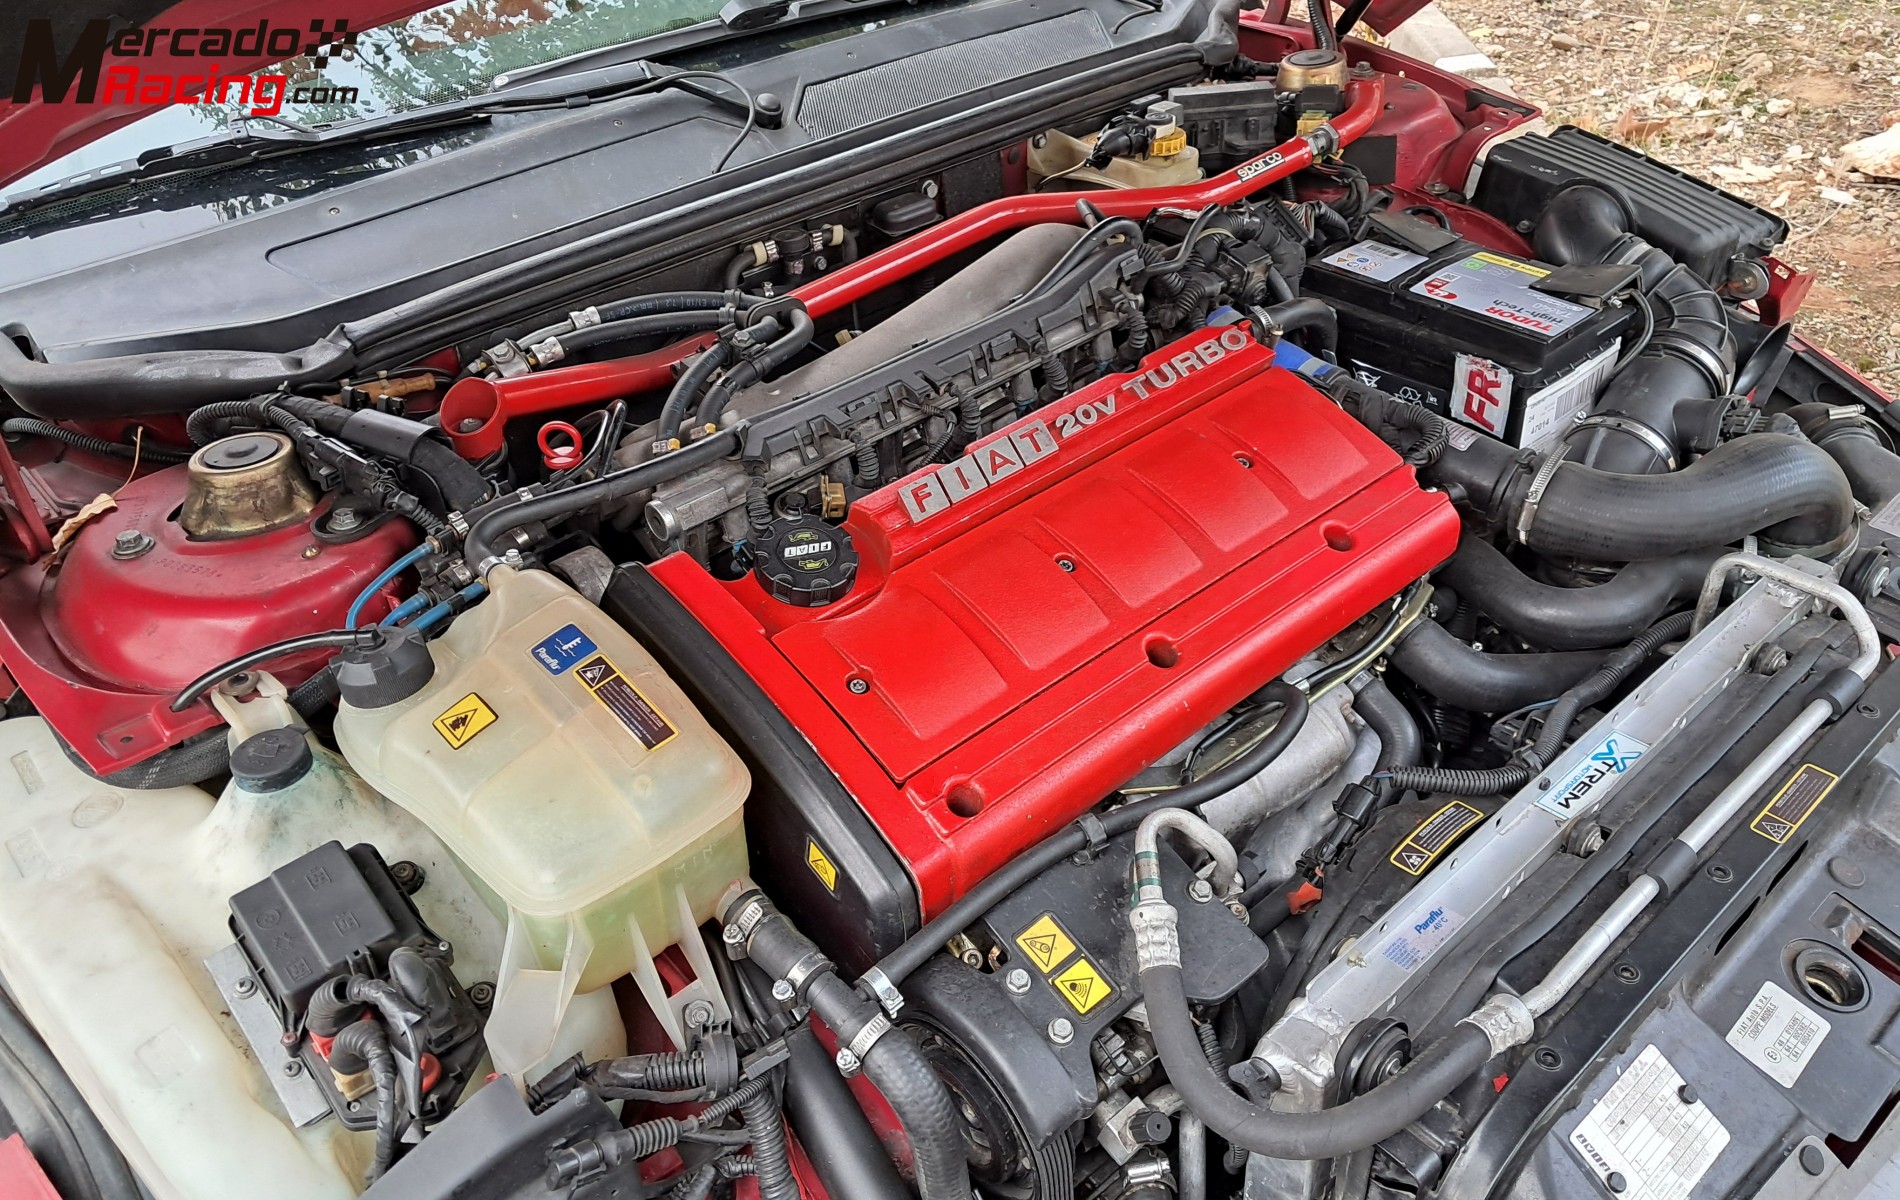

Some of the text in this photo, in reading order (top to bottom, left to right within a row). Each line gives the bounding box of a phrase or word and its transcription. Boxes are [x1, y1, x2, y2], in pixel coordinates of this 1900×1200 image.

[1237, 152, 1284, 180] sparco
[1485, 306, 1554, 332] TUDOR
[1493, 299, 1564, 325] High-Tech
[902, 422, 1054, 520] FIAT
[1121, 329, 1248, 400] TURBO
[784, 541, 832, 557] FIAT
[535, 647, 560, 670] Paraflu
[1553, 764, 1592, 802] MOTORSPORT
[1414, 909, 1443, 934] Paraflu
[1760, 1002, 1777, 1024] MODELS
[1736, 1021, 1749, 1036] FIAT
